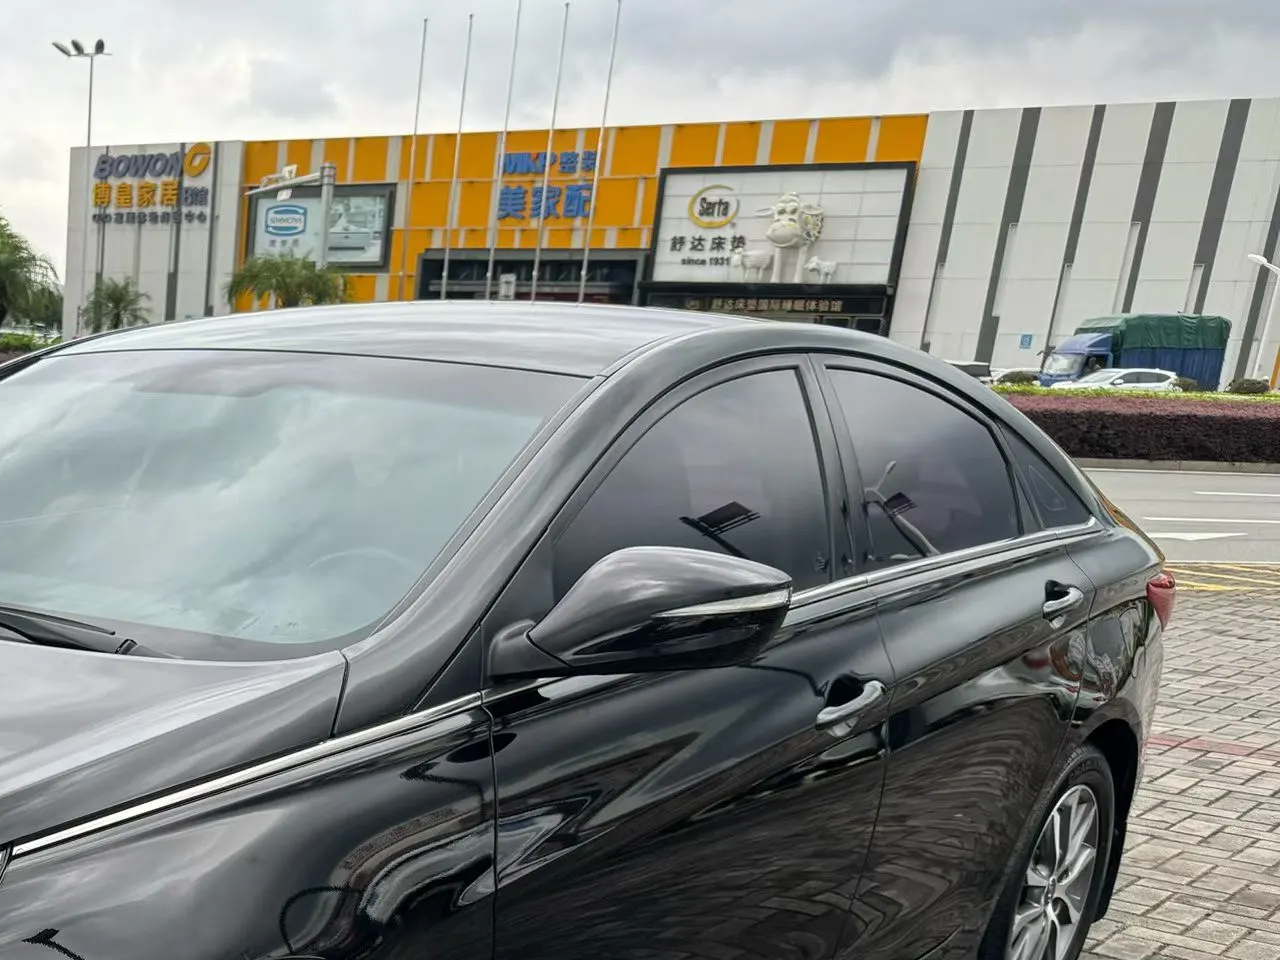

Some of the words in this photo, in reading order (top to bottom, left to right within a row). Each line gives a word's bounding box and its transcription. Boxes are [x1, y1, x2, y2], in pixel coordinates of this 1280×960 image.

[94, 152, 184, 179] BOWON
[498, 184, 593, 220] 美家配
[699, 197, 730, 216] Serta
[670, 236, 746, 252] 舒达床垫
